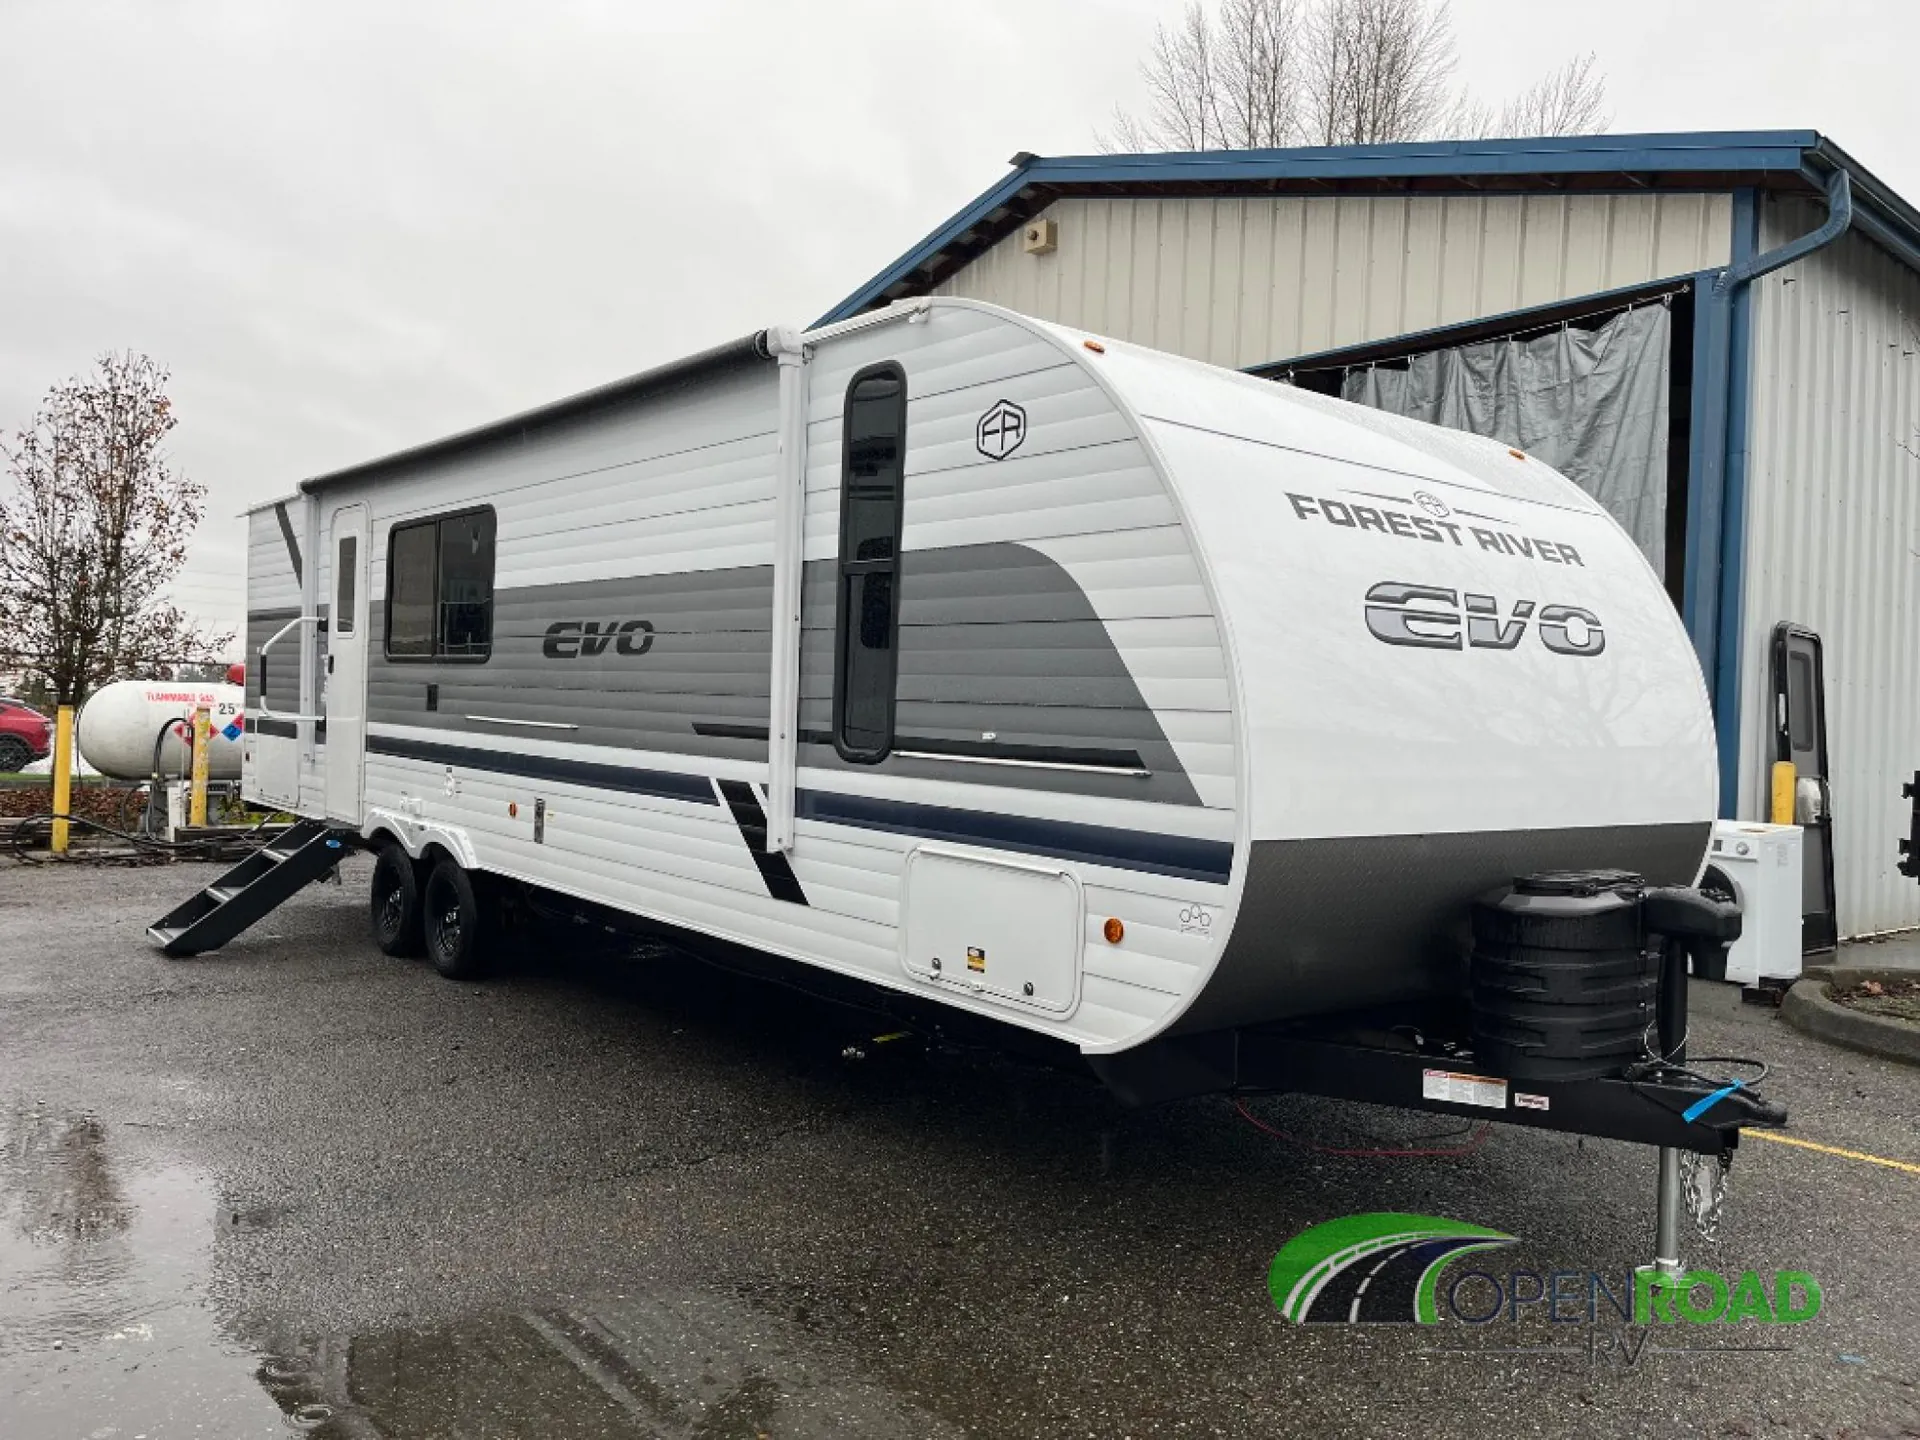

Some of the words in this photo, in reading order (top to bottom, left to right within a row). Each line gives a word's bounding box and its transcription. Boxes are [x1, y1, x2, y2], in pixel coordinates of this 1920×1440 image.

[1284, 492, 1463, 547] FOREST
[1468, 526, 1586, 568] RIVER
[542, 619, 655, 659] EVO
[1364, 580, 1606, 657] EVO
